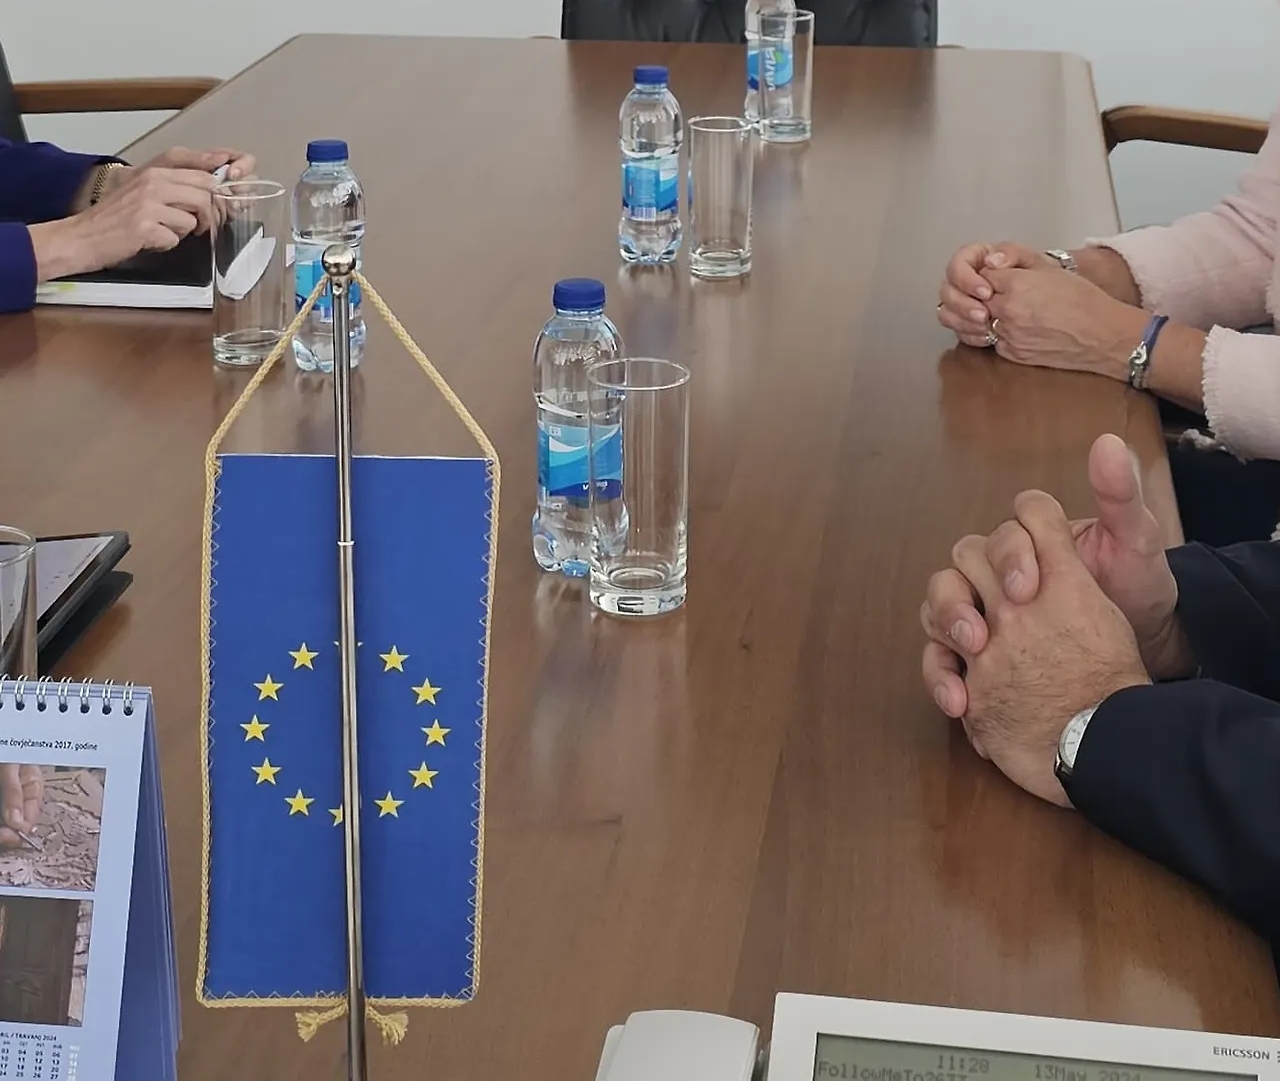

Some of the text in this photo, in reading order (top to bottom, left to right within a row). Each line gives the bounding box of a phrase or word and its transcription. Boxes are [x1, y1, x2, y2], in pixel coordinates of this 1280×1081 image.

[54, 741, 73, 749] 2017.
[75, 743, 97, 751] godine
[1213, 1046, 1270, 1060] ERICSSON
[938, 1055, 989, 1073] 11:28
